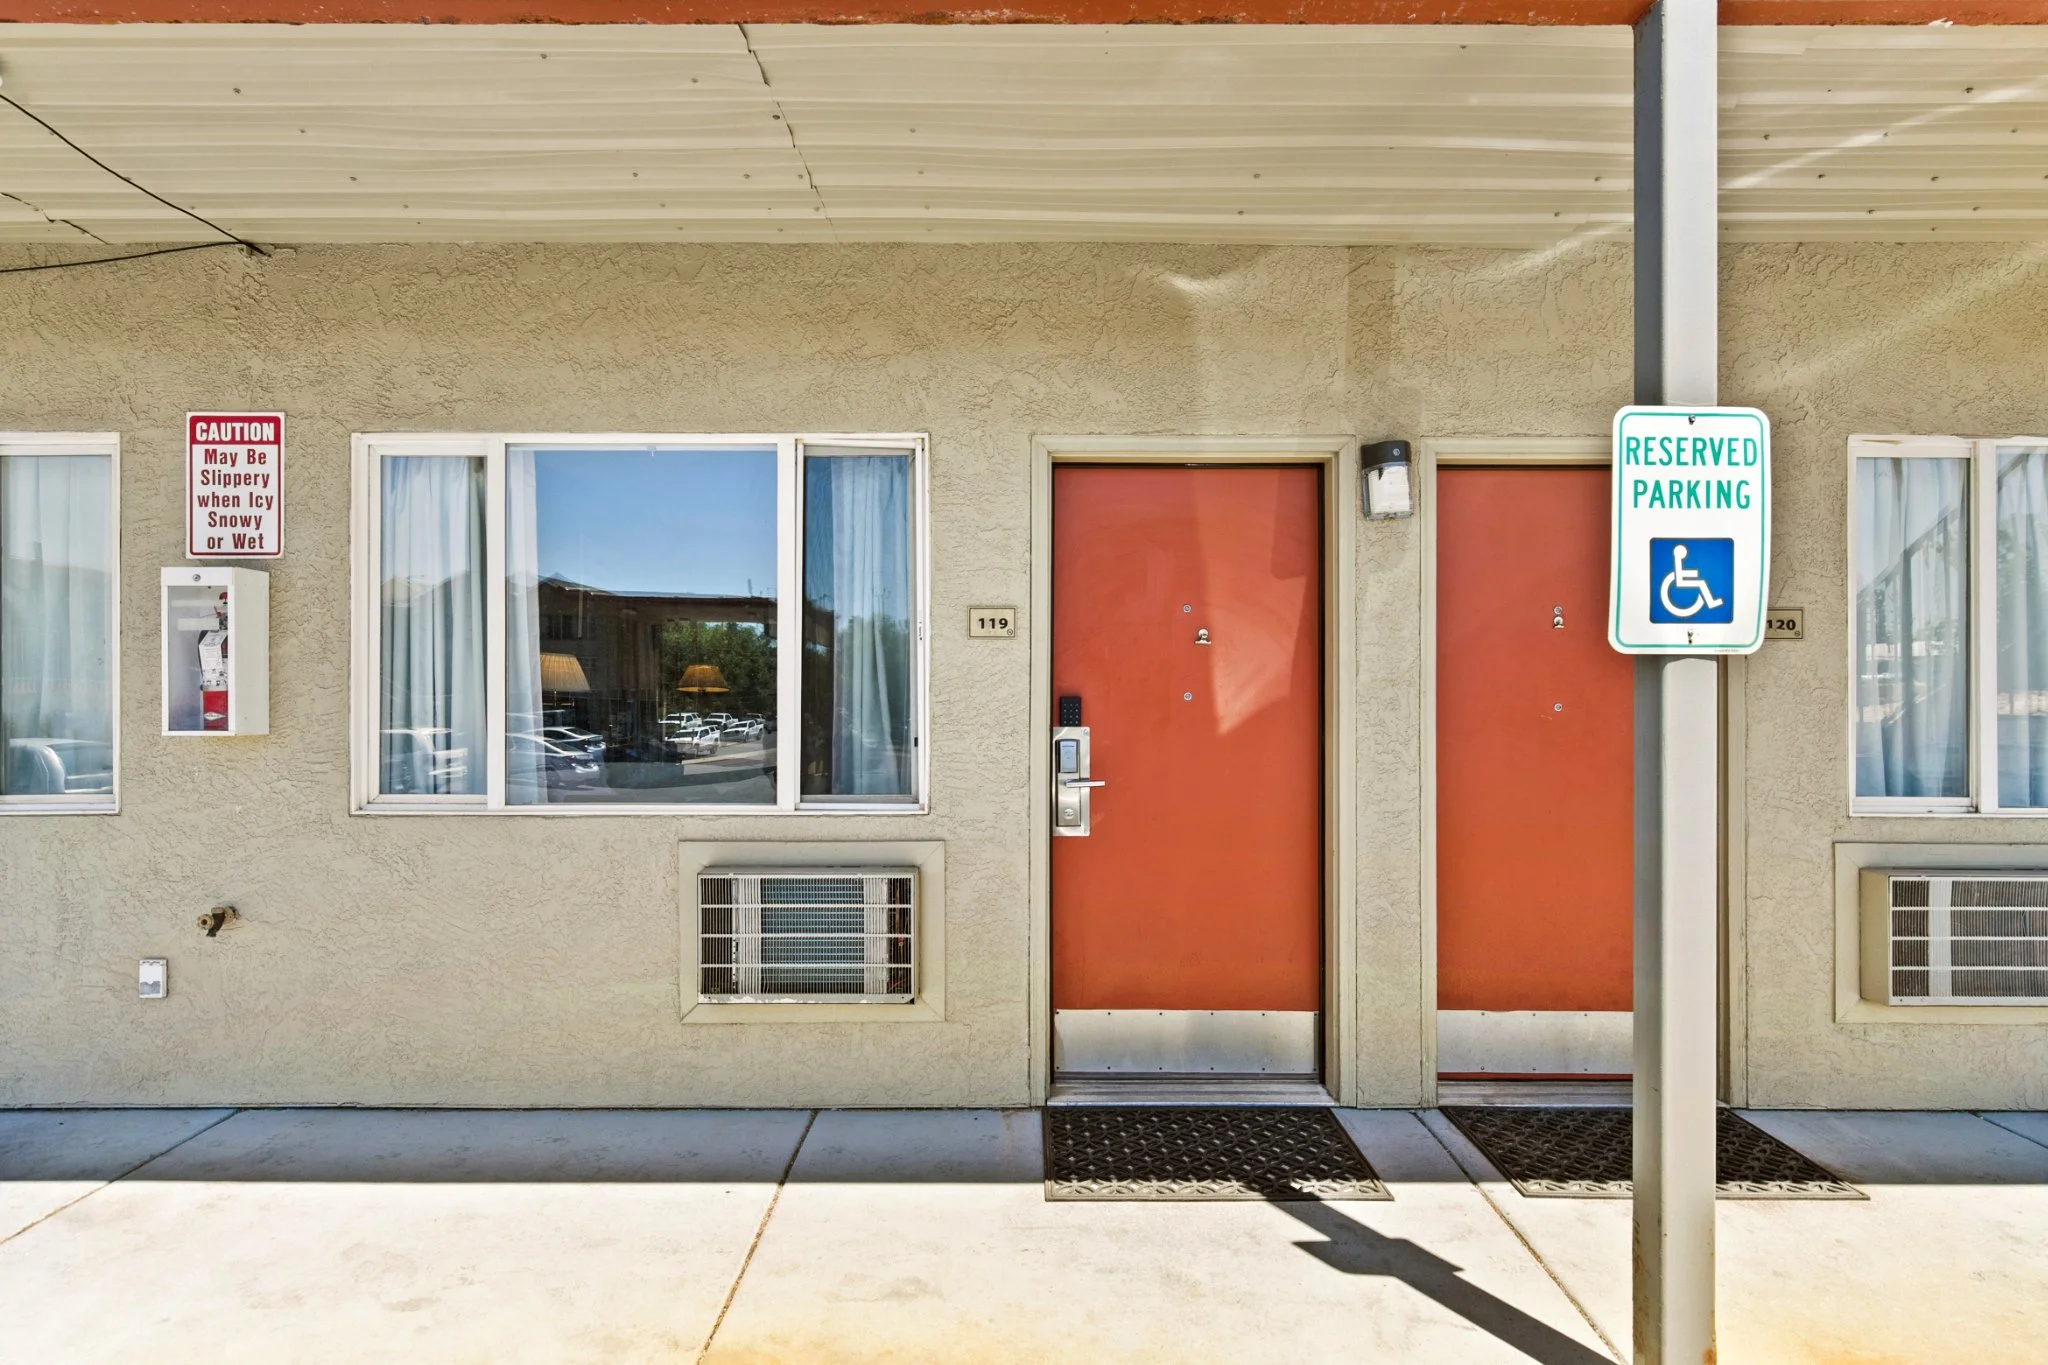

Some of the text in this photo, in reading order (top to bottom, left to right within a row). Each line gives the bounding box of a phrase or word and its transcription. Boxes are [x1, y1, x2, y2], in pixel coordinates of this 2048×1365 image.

[195, 421, 275, 442] CAUTION
[204, 448, 267, 467] May Be
[1626, 436, 1758, 466] RESERVED
[200, 469, 270, 488] Slippery
[197, 491, 274, 510] when Icy
[1633, 479, 1750, 509] PARKING
[207, 511, 263, 530] Snowy
[207, 533, 264, 549] or Wet
[978, 617, 1009, 629] 119
[1766, 619, 1797, 631] 120
